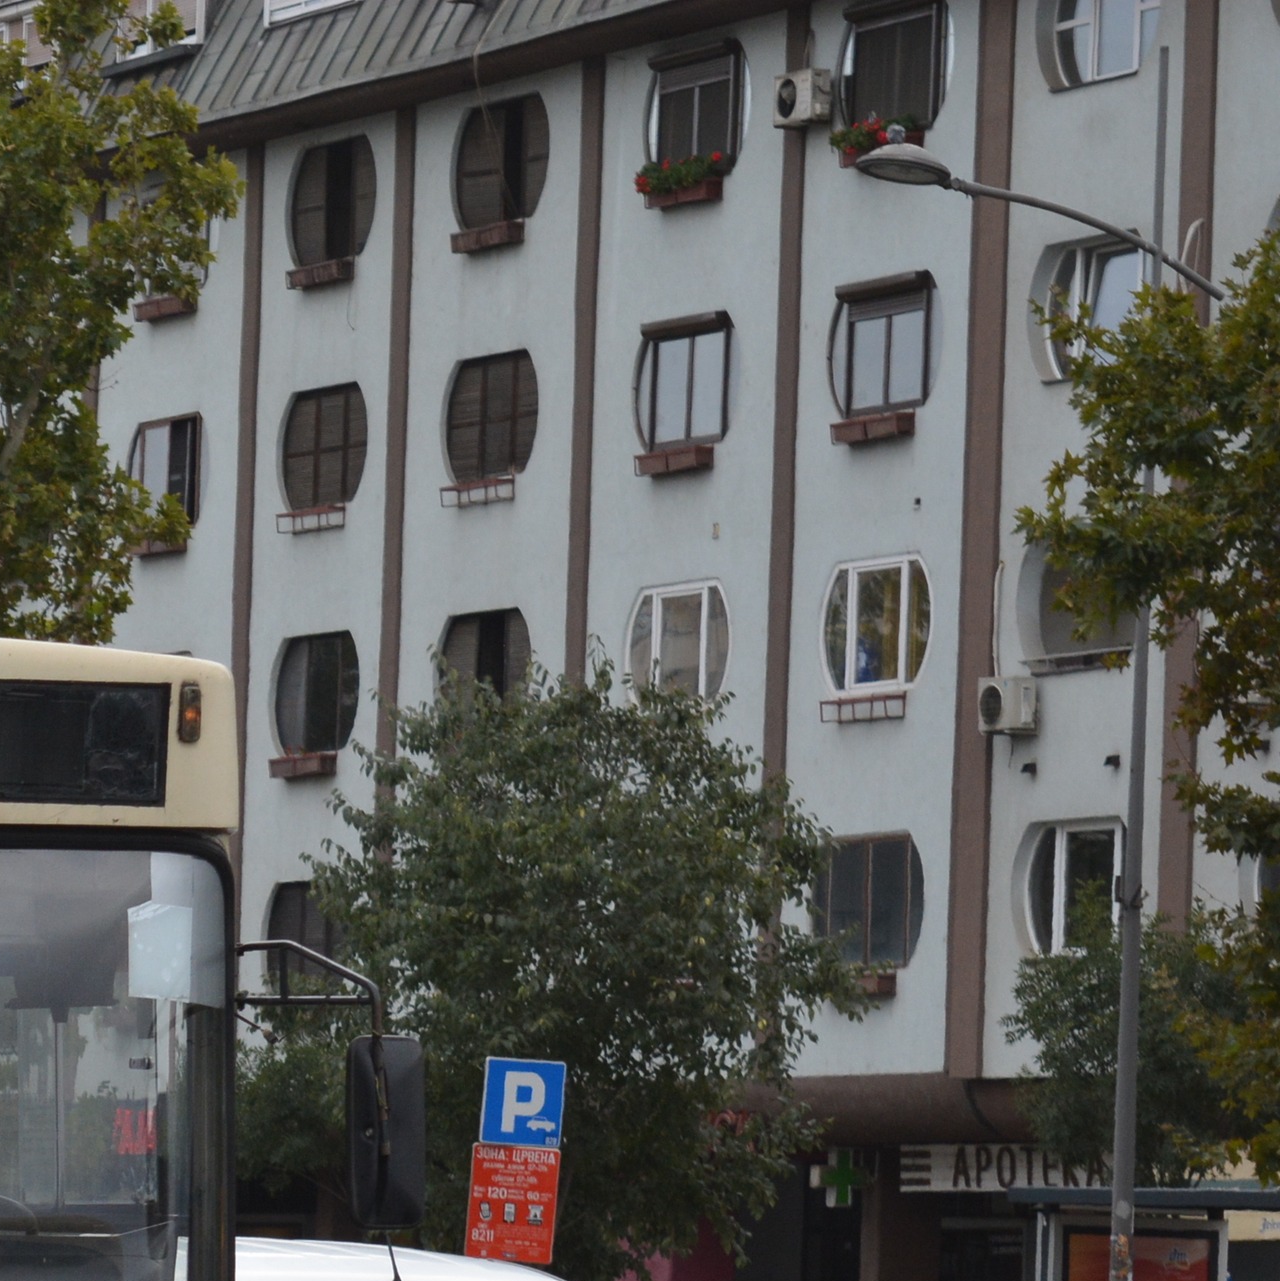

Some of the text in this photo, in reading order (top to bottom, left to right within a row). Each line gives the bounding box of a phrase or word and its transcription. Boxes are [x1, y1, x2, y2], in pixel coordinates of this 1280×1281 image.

[501, 1071, 546, 1133] P
[513, 1149, 556, 1165] ЦРВЕНА
[487, 1187, 508, 1199] 120
[471, 1228, 494, 1242] 8211
